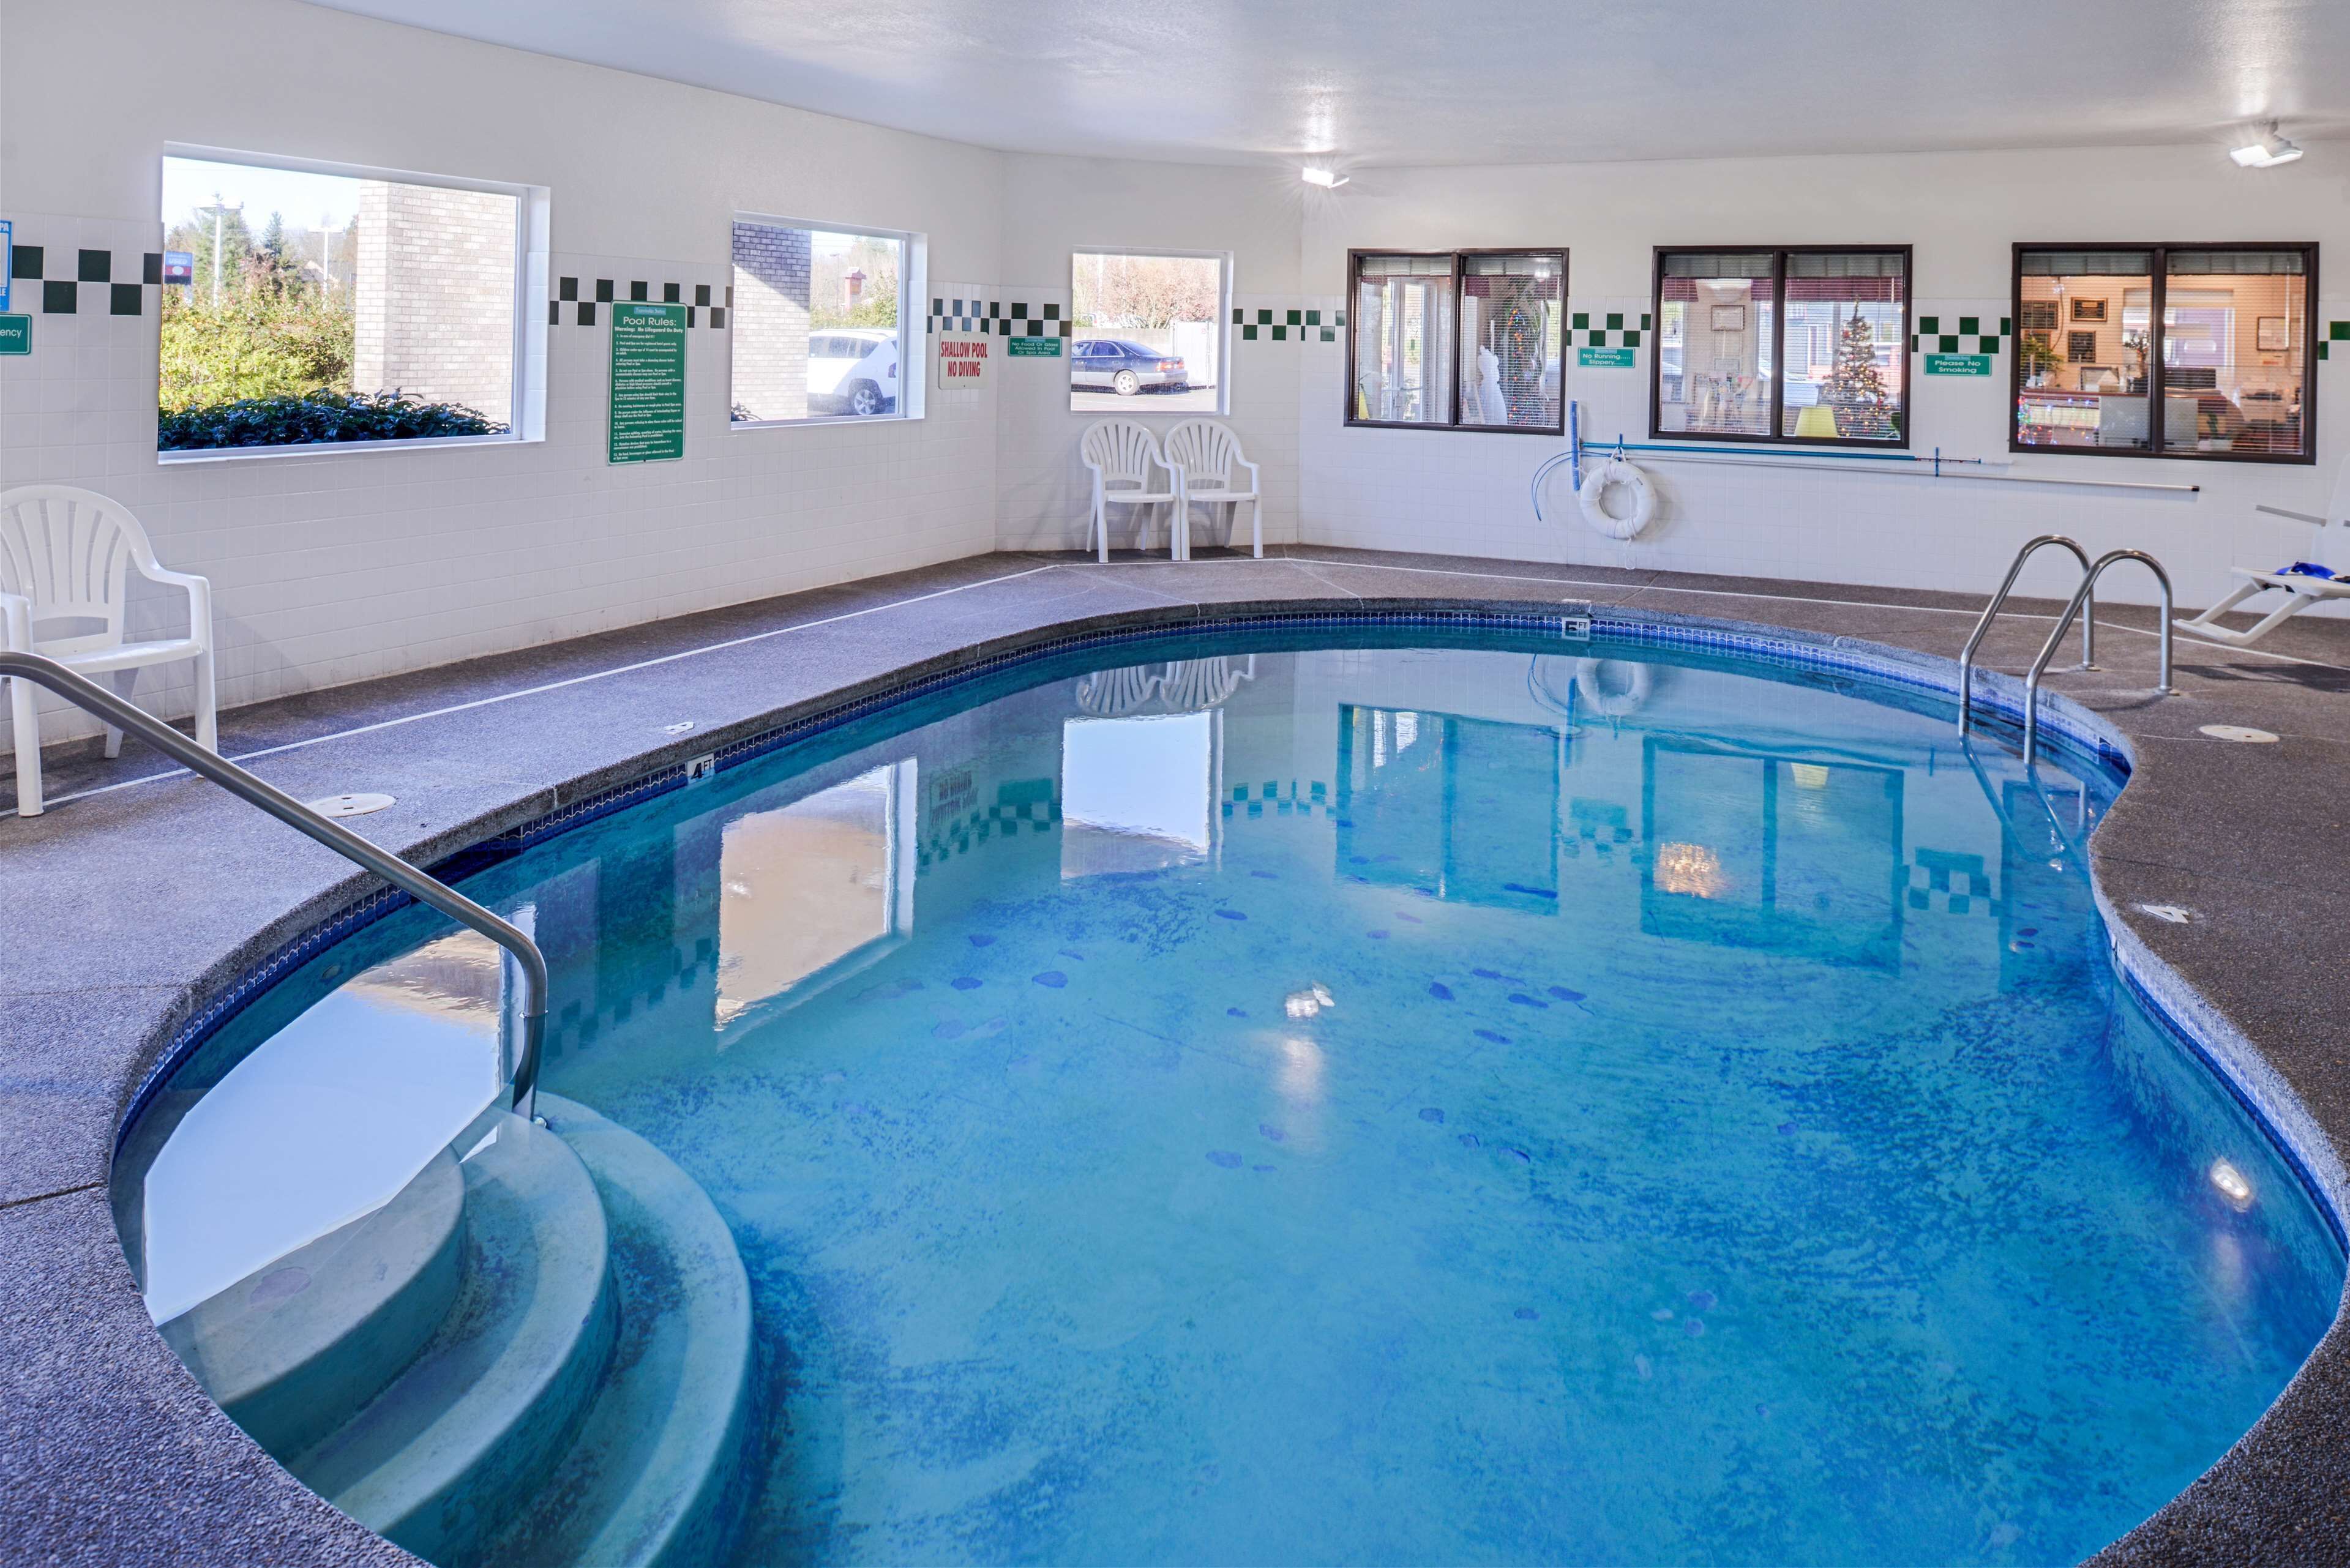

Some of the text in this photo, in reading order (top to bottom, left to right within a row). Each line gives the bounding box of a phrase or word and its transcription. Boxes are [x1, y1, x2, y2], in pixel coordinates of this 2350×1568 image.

[623, 316, 676, 326] Pool Rules:
[941, 341, 987, 358] SHALLOW POOL
[948, 361, 981, 377] NO DIVING
[690, 759, 713, 780] 4 FT
